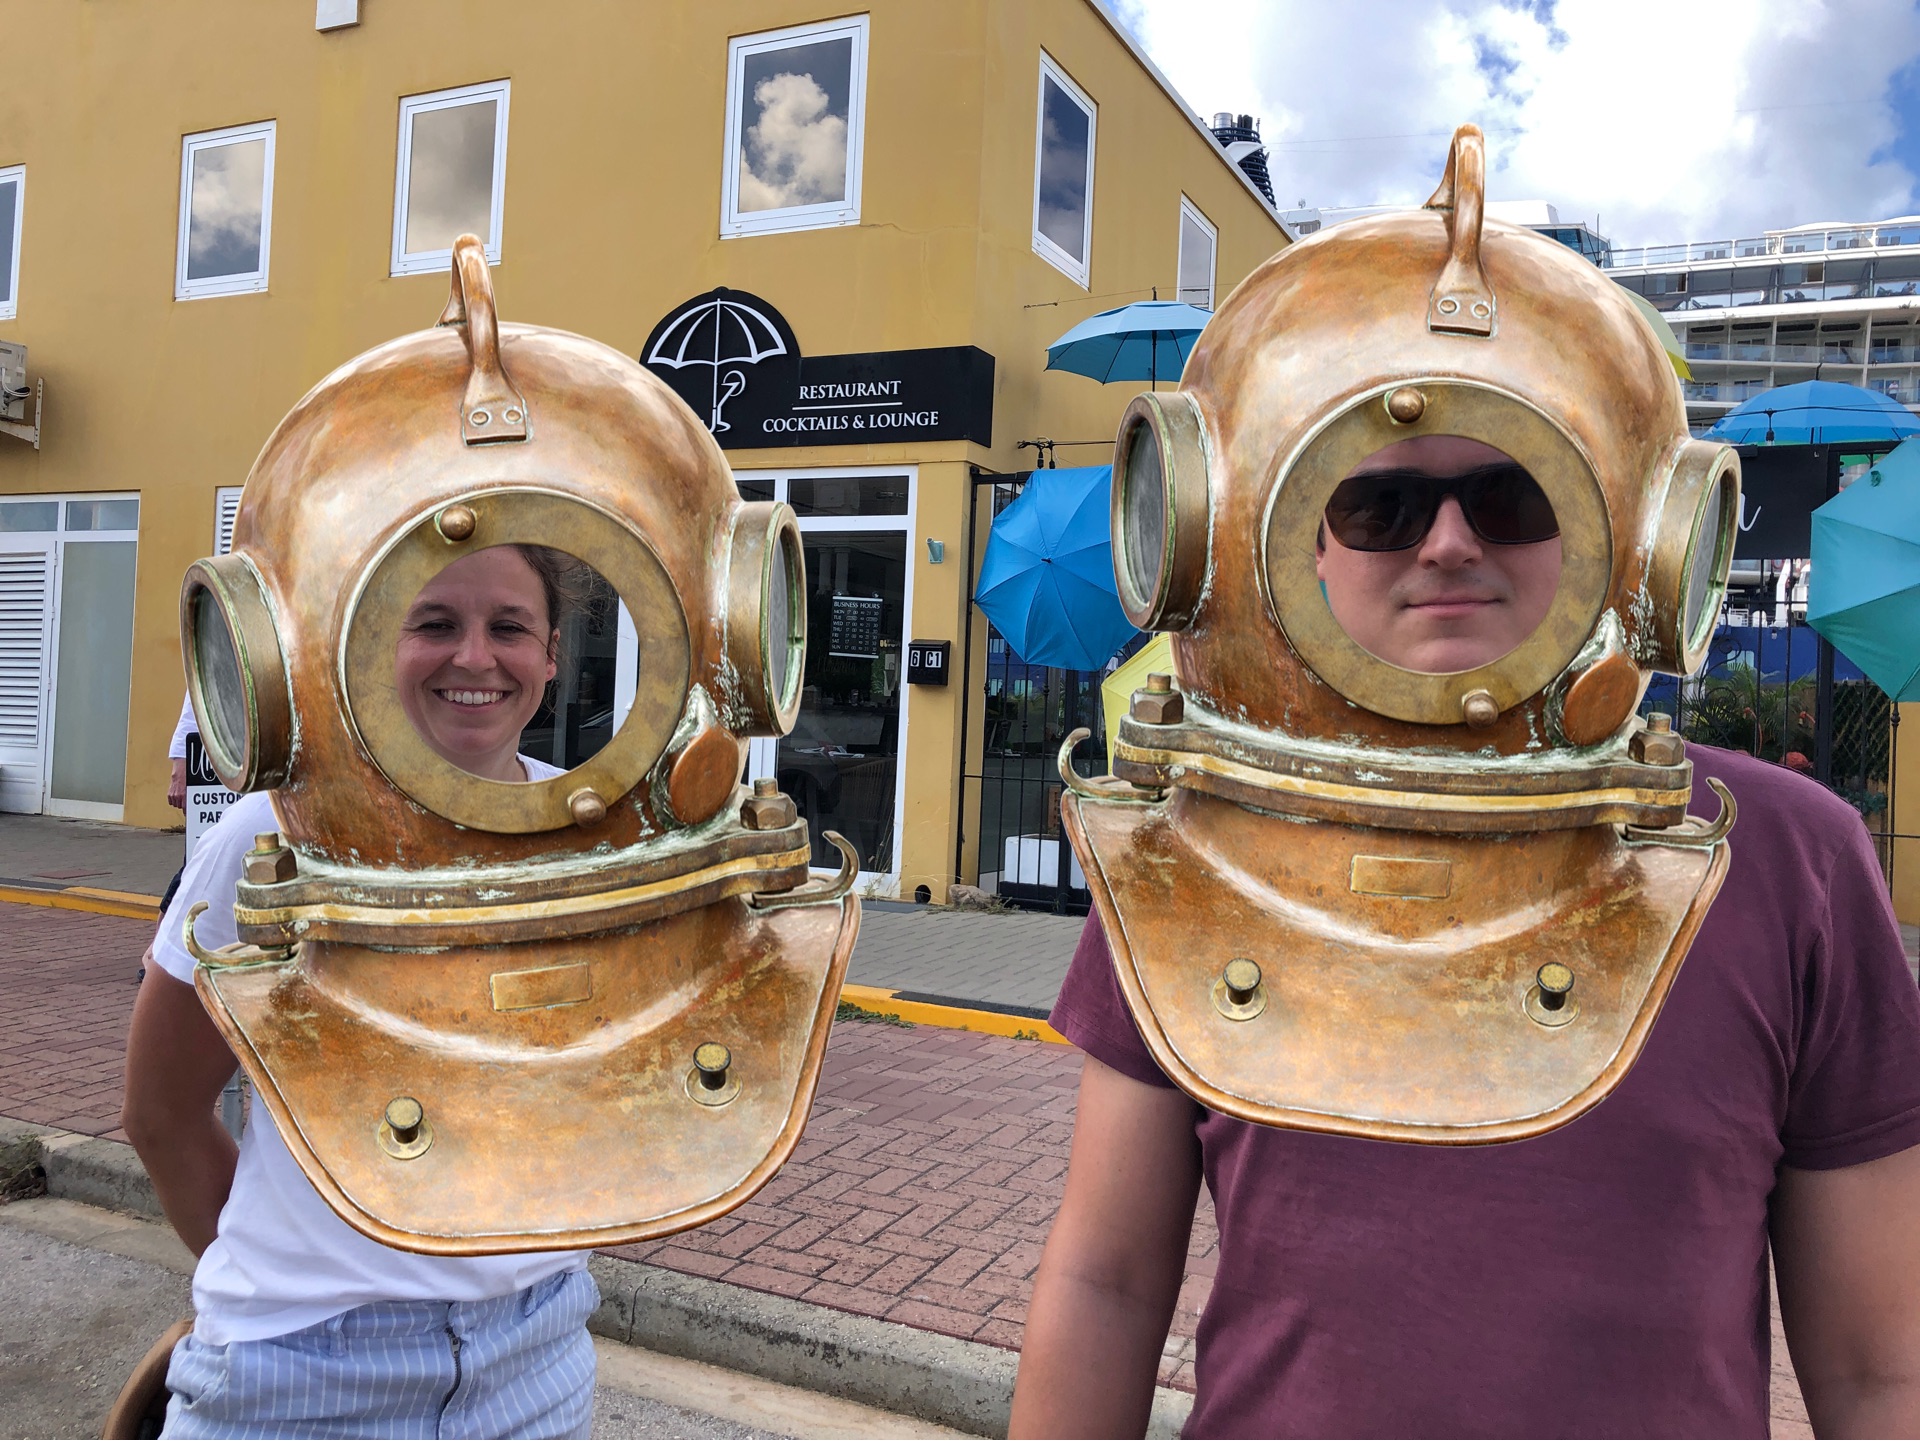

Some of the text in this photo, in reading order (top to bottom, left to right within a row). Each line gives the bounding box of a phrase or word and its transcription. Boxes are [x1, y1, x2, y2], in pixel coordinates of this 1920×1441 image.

[799, 380, 902, 400] RESTAURANT
[762, 411, 939, 433] COCKTAILS & LOUNGE
[912, 652, 940, 666] 6 C1
